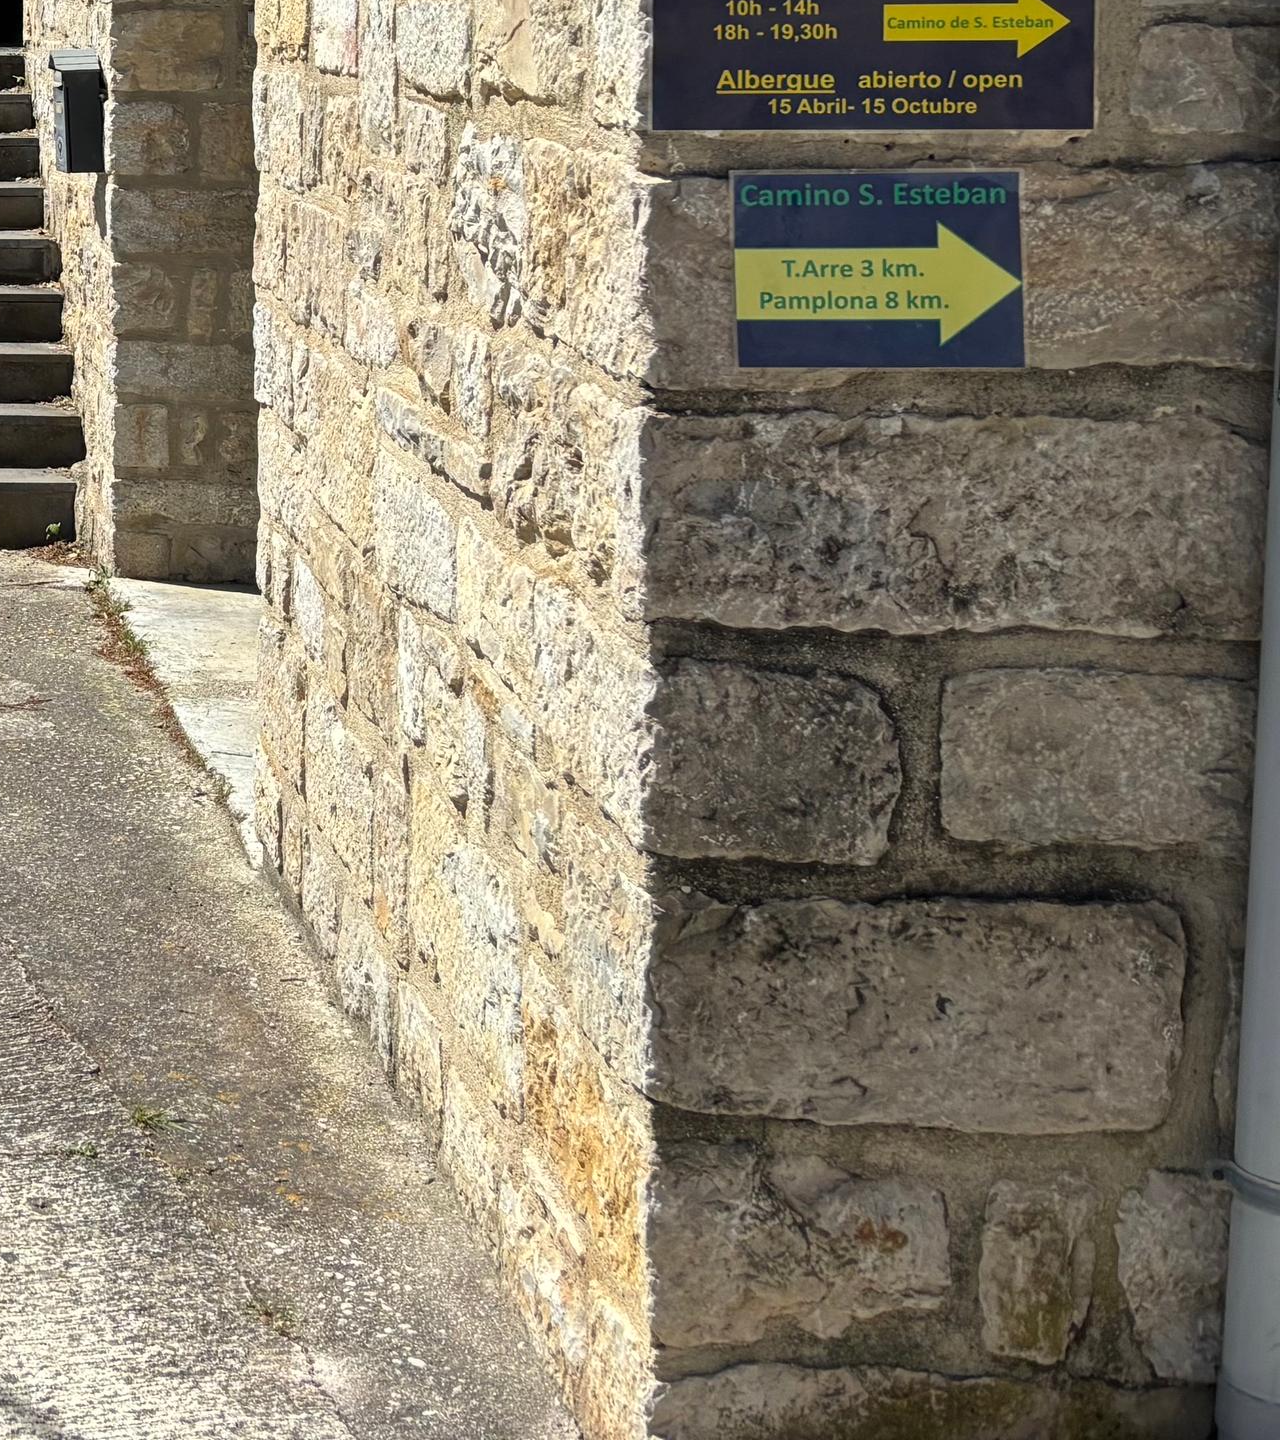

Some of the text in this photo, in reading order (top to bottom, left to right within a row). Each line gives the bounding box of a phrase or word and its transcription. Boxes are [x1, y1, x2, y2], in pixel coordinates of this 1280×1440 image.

[725, 0, 762, 17] 10h
[782, 0, 820, 16] 14h
[713, 24, 750, 40] 18h
[769, 23, 839, 43] 19,30h
[887, 16, 1054, 30] Camino de S. Esteban
[716, 69, 1023, 93] Albergue abierto / open
[768, 98, 792, 115] 15
[861, 97, 886, 115] 15
[891, 97, 978, 115] Octubre
[740, 182, 1007, 208] Camino S. Esteban
[781, 258, 925, 278] T.Arre 3 km.
[760, 290, 949, 314] Pamplona 8 km.
